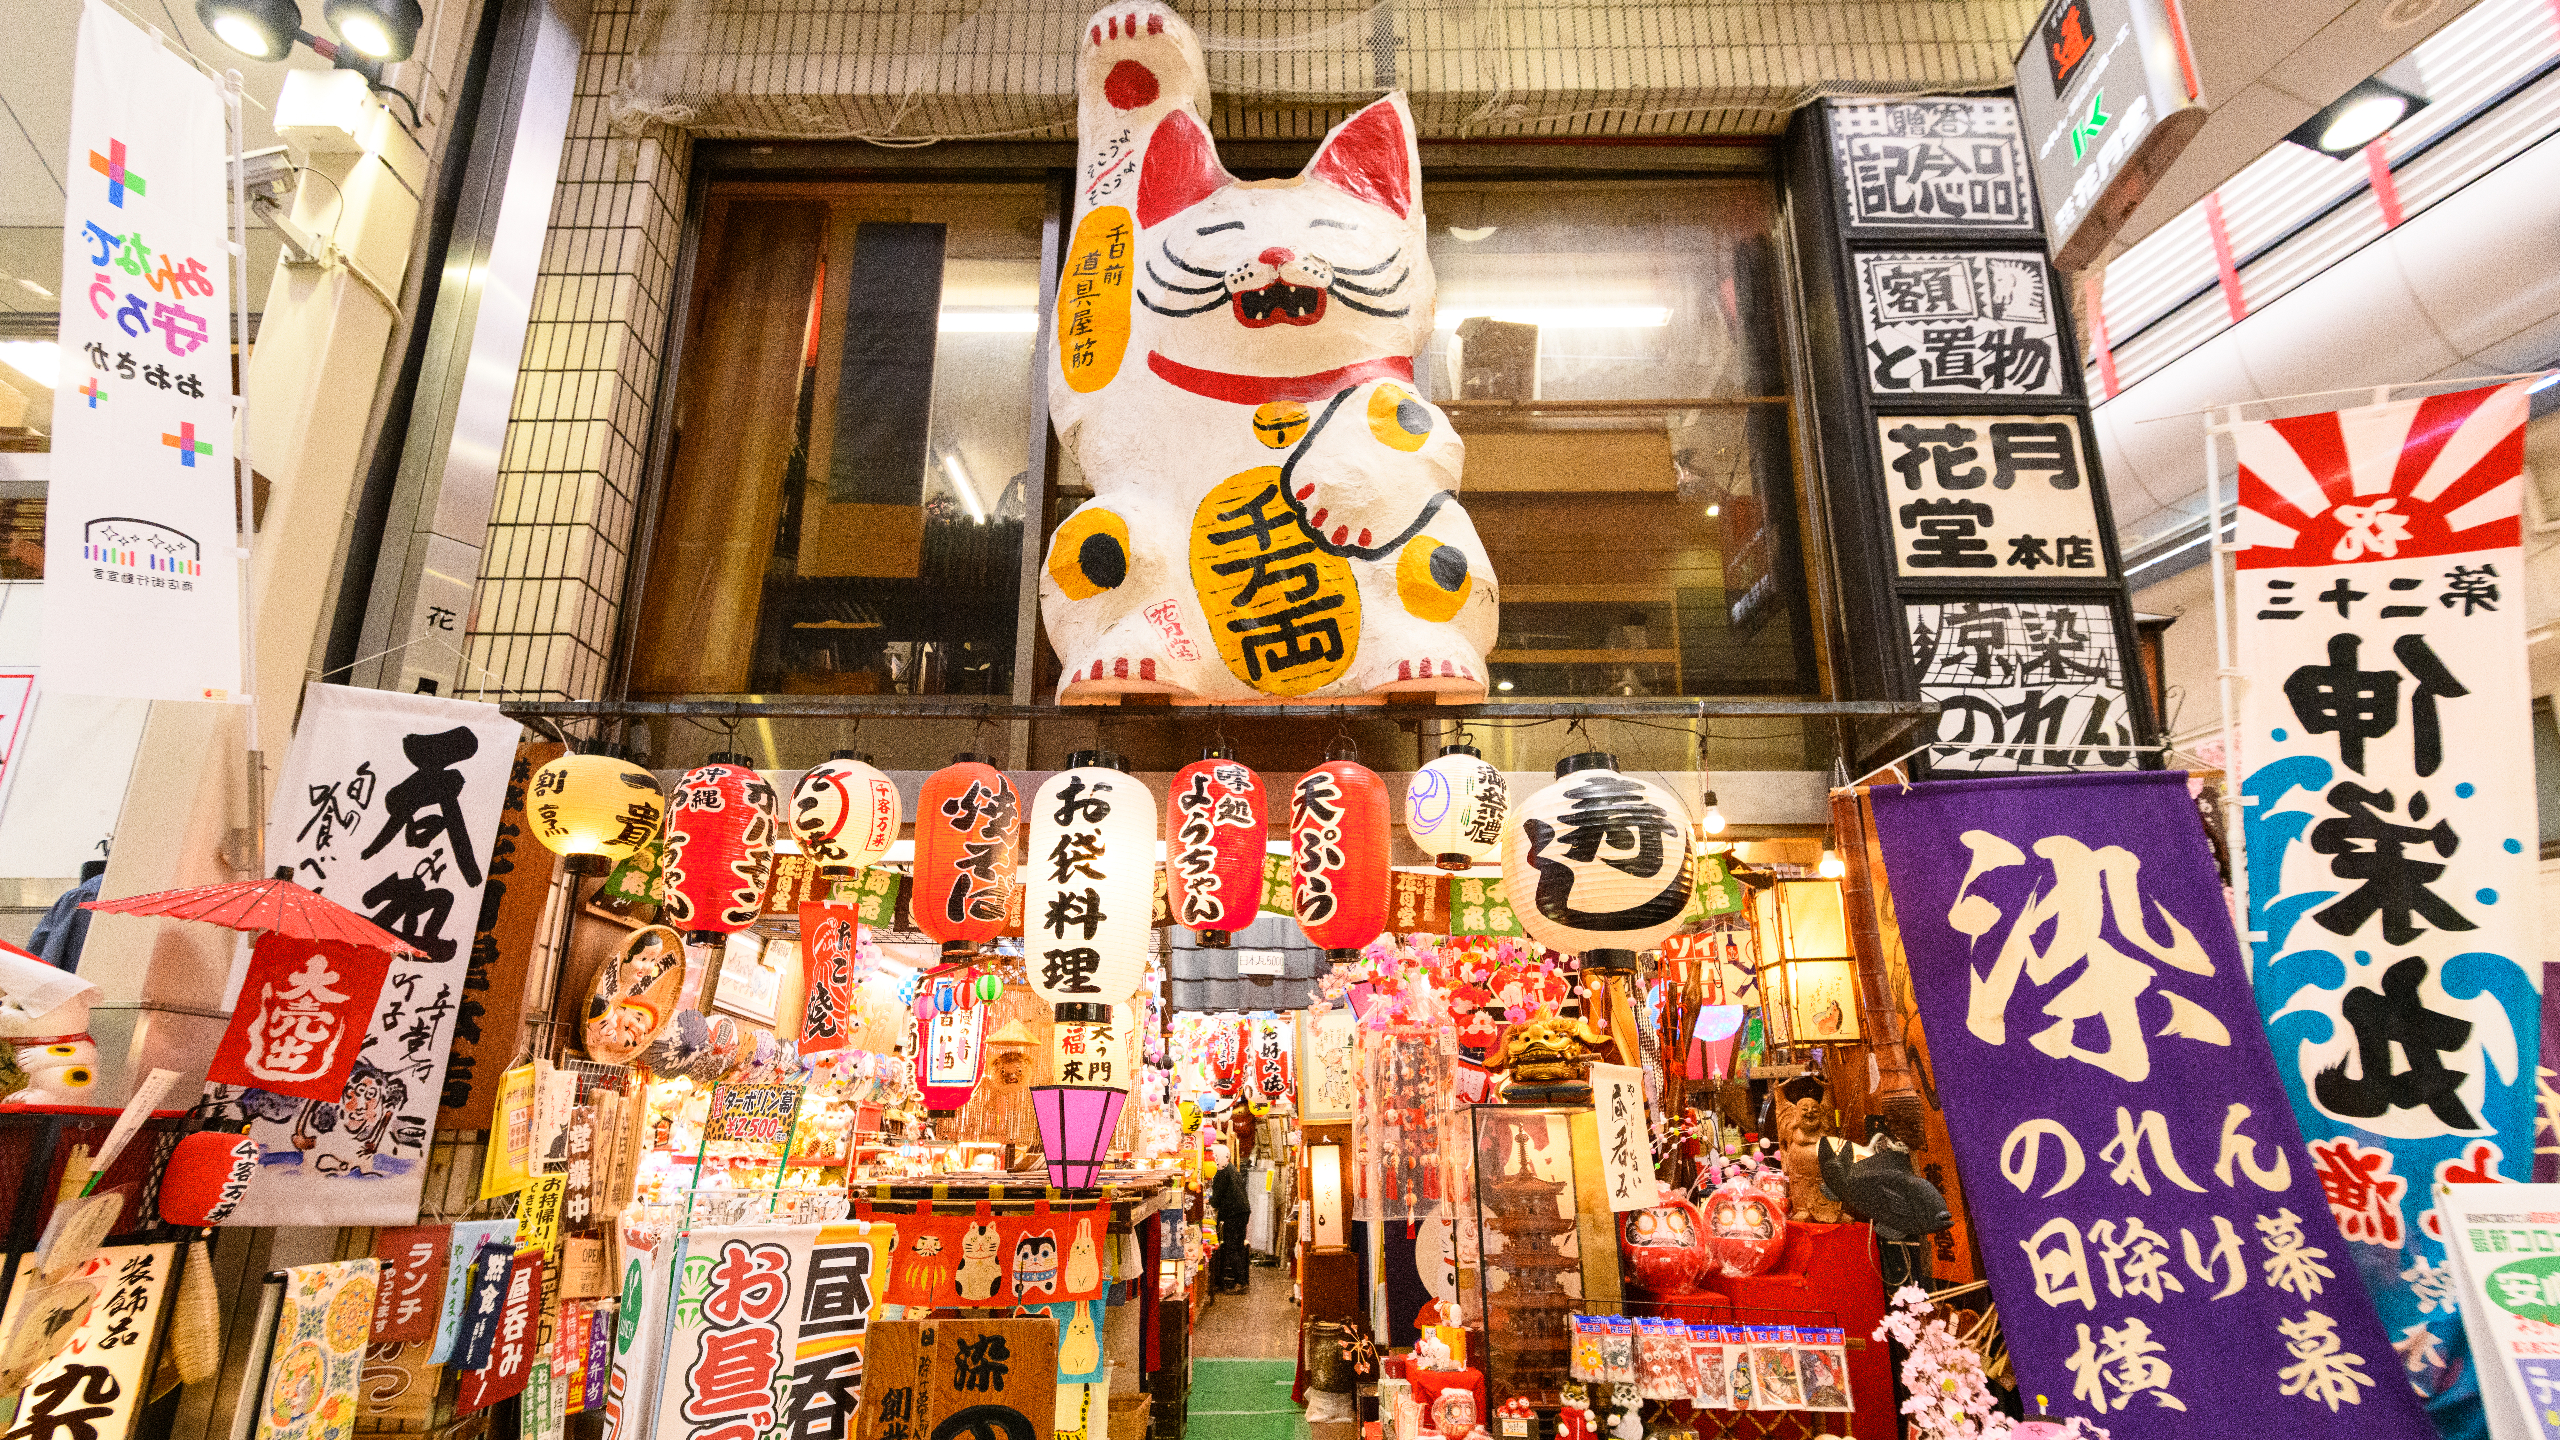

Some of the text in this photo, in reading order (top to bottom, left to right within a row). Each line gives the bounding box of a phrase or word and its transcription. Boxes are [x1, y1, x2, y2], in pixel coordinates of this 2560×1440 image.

[1856, 143, 2027, 220] 記念品
[1103, 224, 1129, 286] 千日前
[1884, 266, 1956, 314] 額
[1069, 249, 1102, 369] 道具屋筋
[1870, 327, 2052, 390] と置物
[1888, 422, 2080, 490] 花月
[1206, 483, 1345, 683] 千万両
[2007, 536, 2094, 571] 本店
[1933, 688, 2131, 771] のれん
[535, 769, 569, 837] 割烹
[603, 771, 665, 853] 一貴
[691, 767, 727, 809] 沖縄
[872, 784, 891, 847] 千客万来
[1216, 768, 1252, 823] 味処
[944, 775, 1019, 921] 焼そば
[1042, 776, 1112, 993] お袋料理
[1175, 776, 1222, 922] ようちゃん
[1291, 773, 1344, 924] 天ぷら
[1523, 777, 1692, 931] 寿し
[1669, 938, 1690, 995] ソー
[1949, 829, 2231, 1082] 染
[206, 1140, 258, 1222] 千客万来
[568, 1123, 591, 1222] 営業中
[2000, 1103, 2292, 1198] のれん
[396, 1243, 434, 1325] ランチ
[2019, 1207, 2335, 1310] 日除け幕
[98, 1254, 154, 1349] 装飾品
[375, 1267, 397, 1333] やってます
[499, 1267, 532, 1378] 昼呑み
